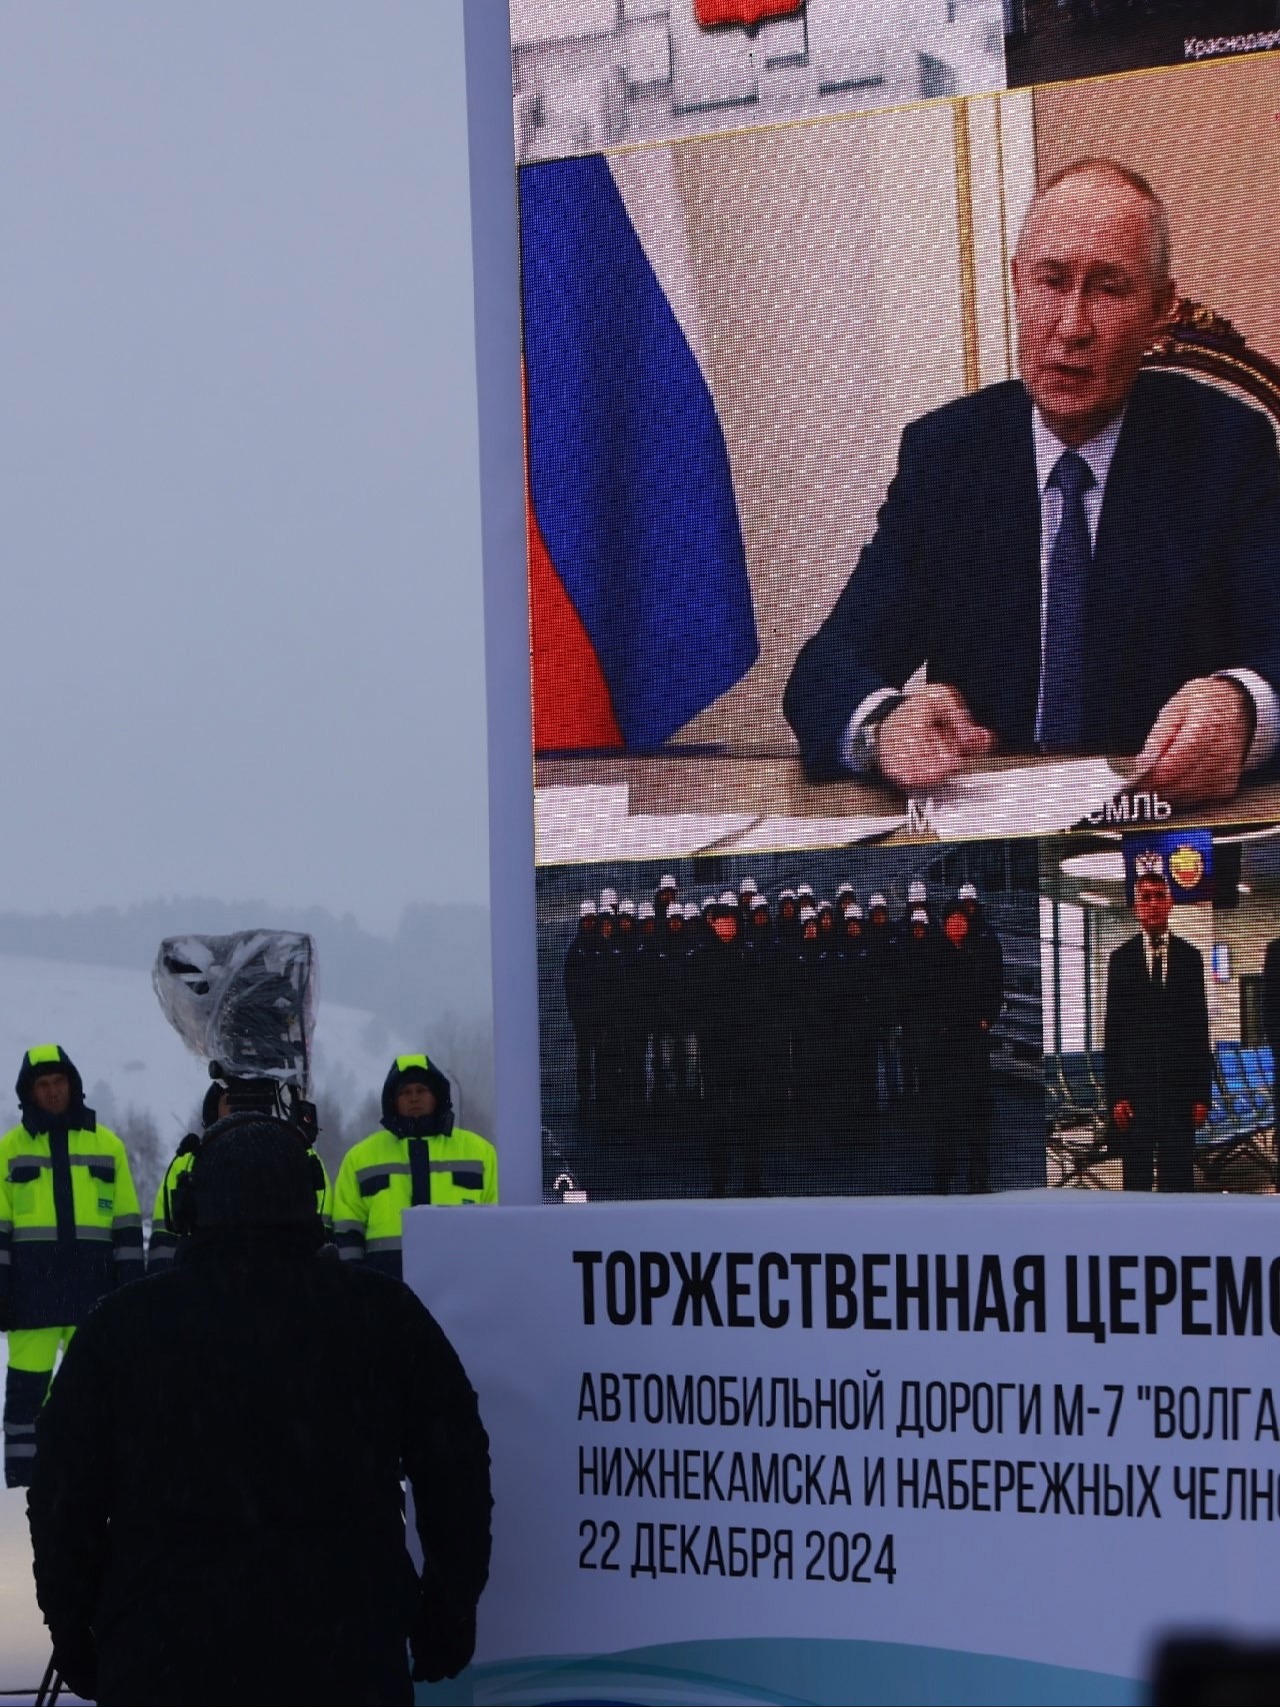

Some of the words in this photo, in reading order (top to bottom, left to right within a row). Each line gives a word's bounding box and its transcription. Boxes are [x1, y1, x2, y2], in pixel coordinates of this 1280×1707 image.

[572, 1249, 1047, 1333] ТОРЖЕСТВЕННАЯ
[576, 1368, 884, 1431] АВТОМОБИЛЬНОЙ
[895, 1380, 1042, 1439] ДОРОГИ
[1054, 1383, 1124, 1437] М-7
[1137, 1384, 1280, 1442] "ВОЛГА
[578, 1444, 852, 1506] НИЖНЕКАМСКА
[863, 1456, 885, 1507] И
[896, 1457, 1162, 1519] НАБЕРЕЖНЫХ
[1173, 1465, 1280, 1522] ЧЕЛН
[578, 1518, 621, 1571] 22
[629, 1520, 794, 1581] ДЕКАБРЯ
[805, 1530, 897, 1585] 2024
